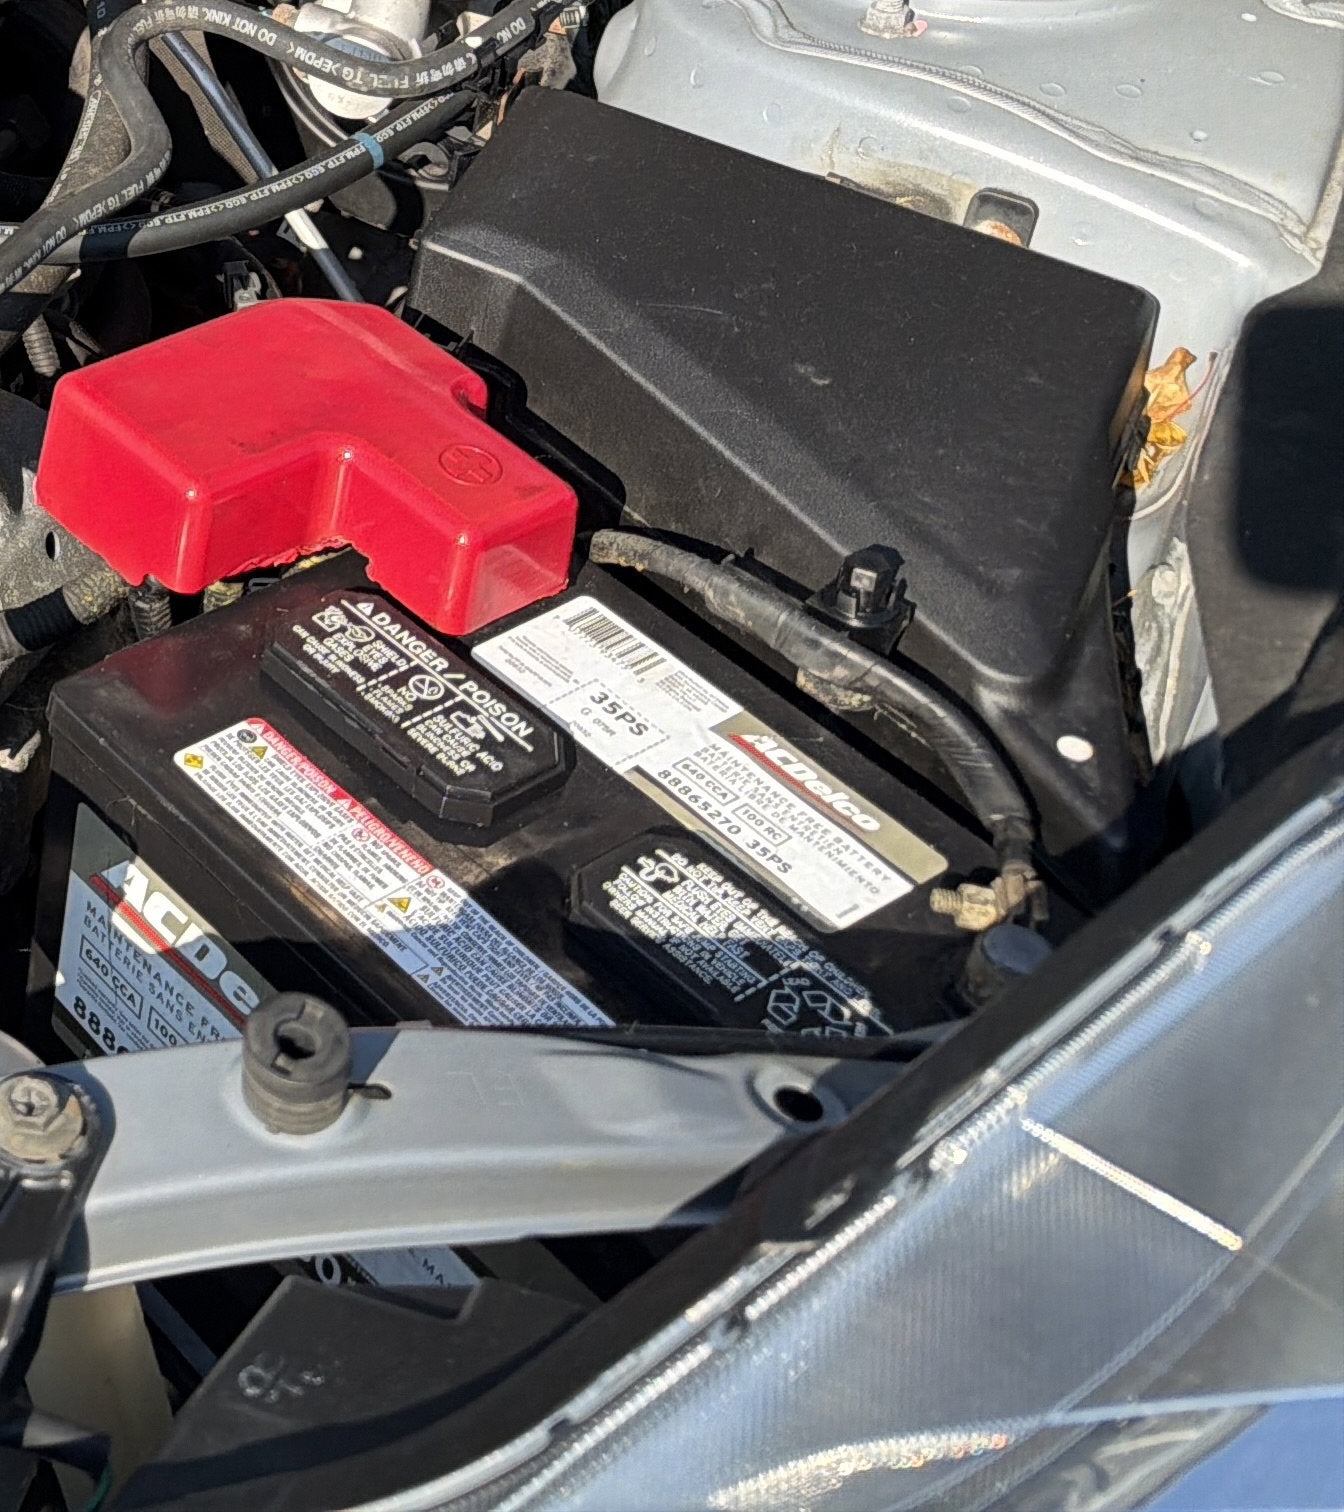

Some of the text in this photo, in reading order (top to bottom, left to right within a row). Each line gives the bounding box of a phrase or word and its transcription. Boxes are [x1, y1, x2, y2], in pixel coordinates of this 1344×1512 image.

[232, 16, 258, 37] NOT
[257, 28, 278, 46] DO
[342, 64, 364, 84] TG
[369, 638, 409, 667] SHIELD
[369, 611, 451, 671] DANGER
[456, 679, 536, 737] POISON
[394, 685, 420, 702] NO
[429, 713, 483, 753] SULFURIC
[586, 690, 653, 737] 35PS
[679, 762, 731, 800] 640 CCA
[698, 746, 753, 785] BATTERIE
[749, 786, 782, 809] SANS
[735, 727, 889, 834] ACDelco
[652, 768, 795, 875] 88865270 35PS
[704, 742, 895, 883] MAINTENANCE FREE BATTERY
[739, 808, 783, 840] 100 RC
[669, 851, 691, 867] DO
[684, 864, 709, 882] NOT
[695, 861, 725, 883] KEEP
[769, 810, 789, 824] DE
[784, 823, 883, 895] MANTENIMIENTO
[679, 878, 715, 904] FLUSH
[708, 901, 738, 923] EYES
[100, 862, 261, 1016] ACDe
[450, 935, 476, 953] ACID
[659, 889, 751, 959] MEDICAL HELP FAST
[82, 914, 146, 985] BATTERIE
[147, 980, 184, 1023] SANS
[83, 900, 196, 1018] MAINTENANCE
[199, 1016, 224, 1046] FR
[435, 934, 486, 975] SULFURIQUE
[708, 958, 746, 986] VEHICLE
[712, 949, 758, 984] STARTING
[84, 946, 138, 1008] 640 CCA
[73, 996, 130, 1054] 888
[152, 1016, 178, 1049] 100
